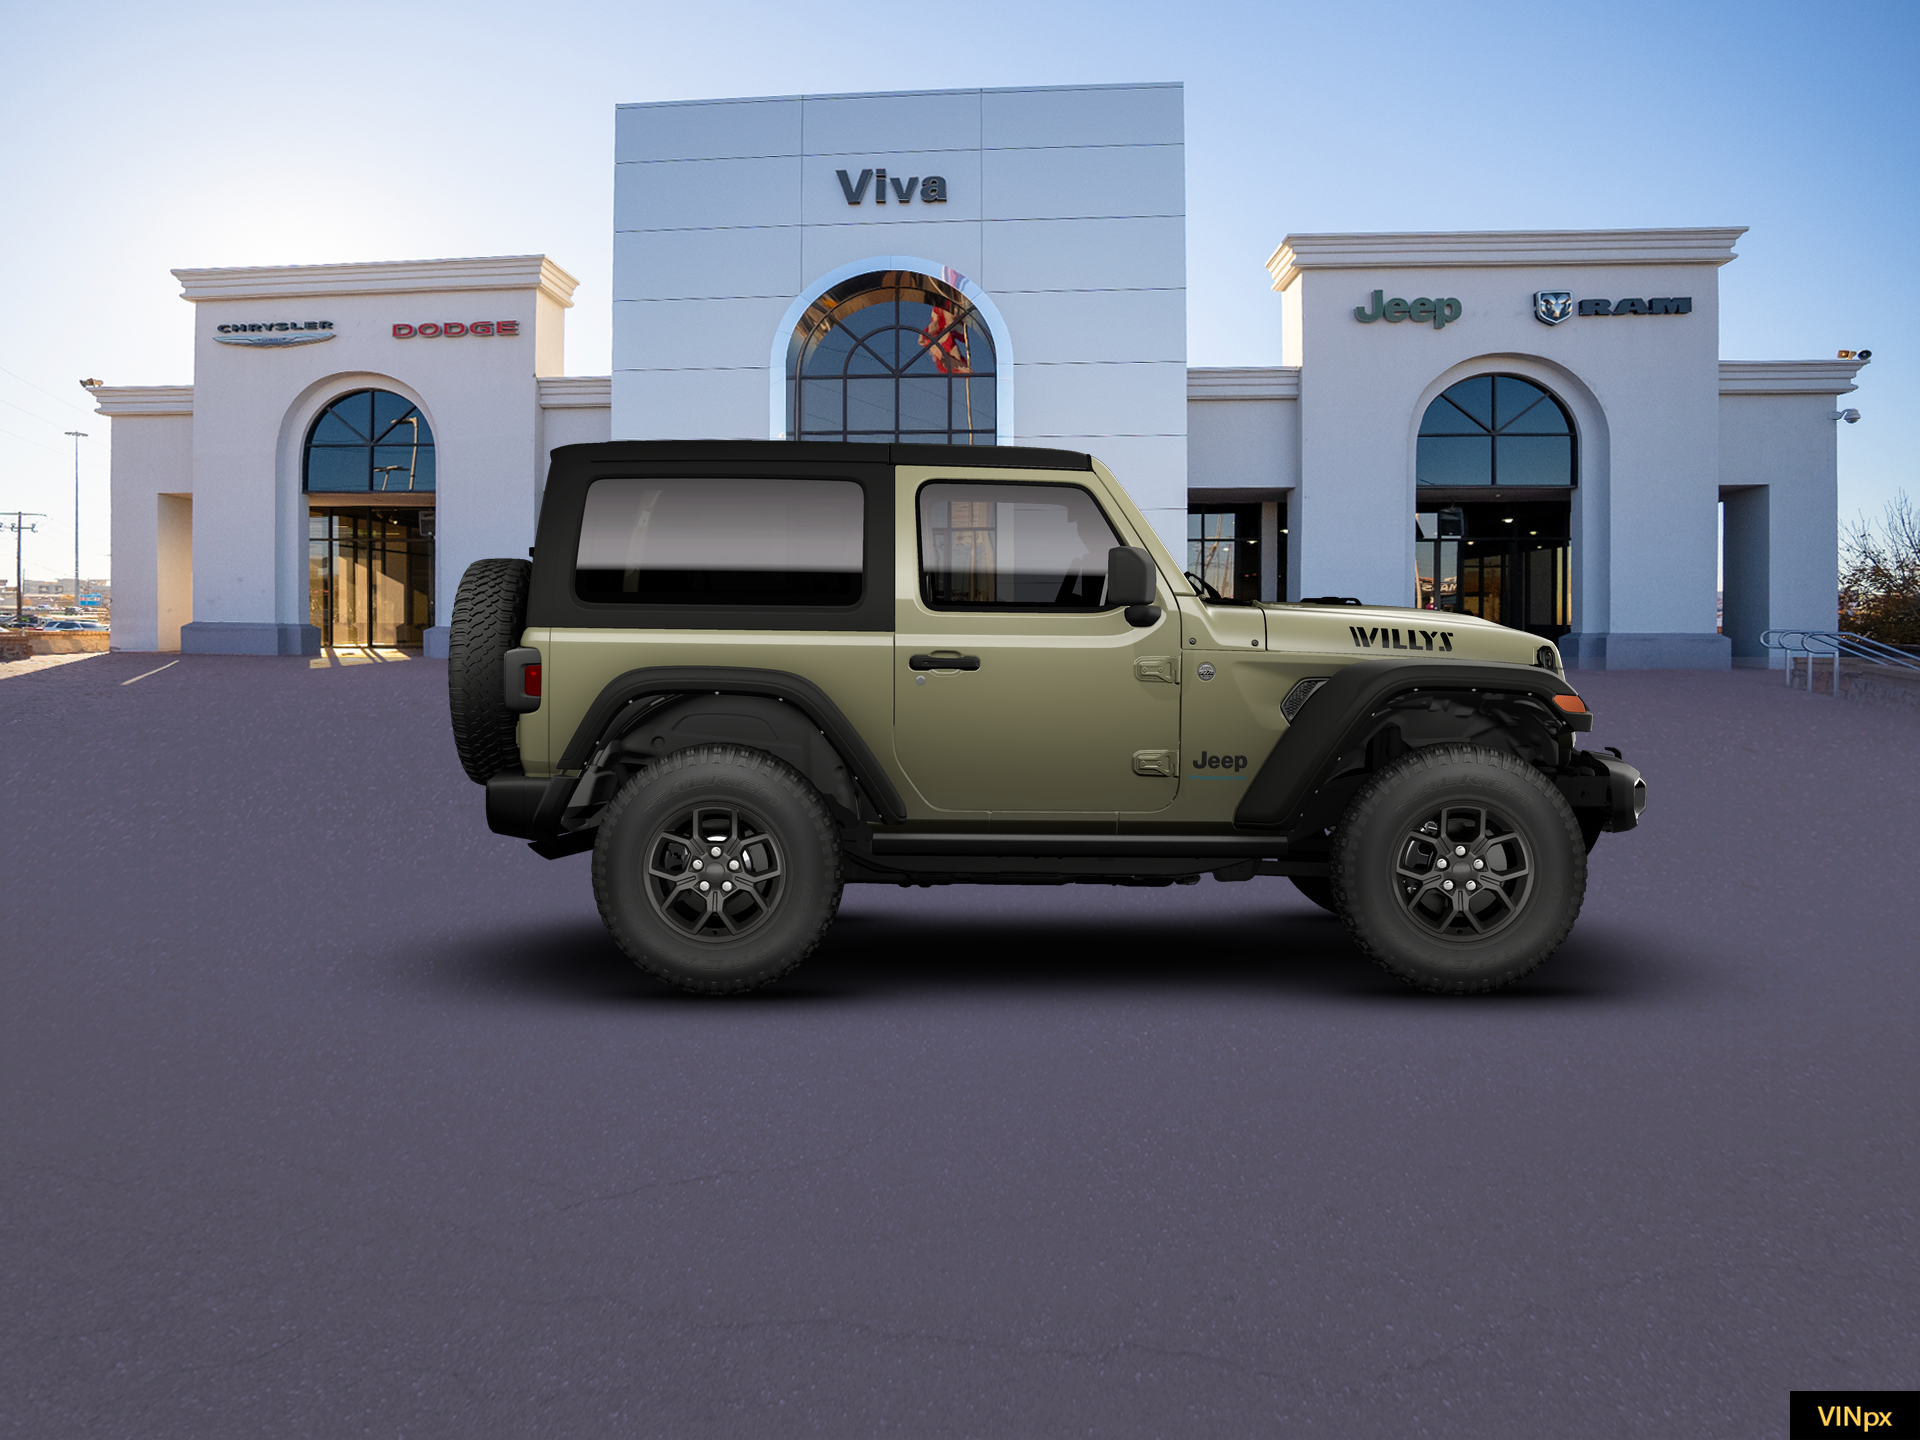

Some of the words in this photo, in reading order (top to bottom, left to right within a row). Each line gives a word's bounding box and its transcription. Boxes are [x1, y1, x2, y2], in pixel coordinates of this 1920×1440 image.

[835, 168, 947, 205] Viva
[1353, 289, 1462, 330] Jeep
[1578, 297, 1692, 316] RAM
[217, 320, 334, 334] CHRYSLER
[392, 320, 520, 339] DODGE
[1349, 626, 1454, 652] WILLYS
[1193, 751, 1248, 772] Jeep
[643, 774, 782, 813] FALKEN
[1394, 774, 1534, 812] FALKEN
